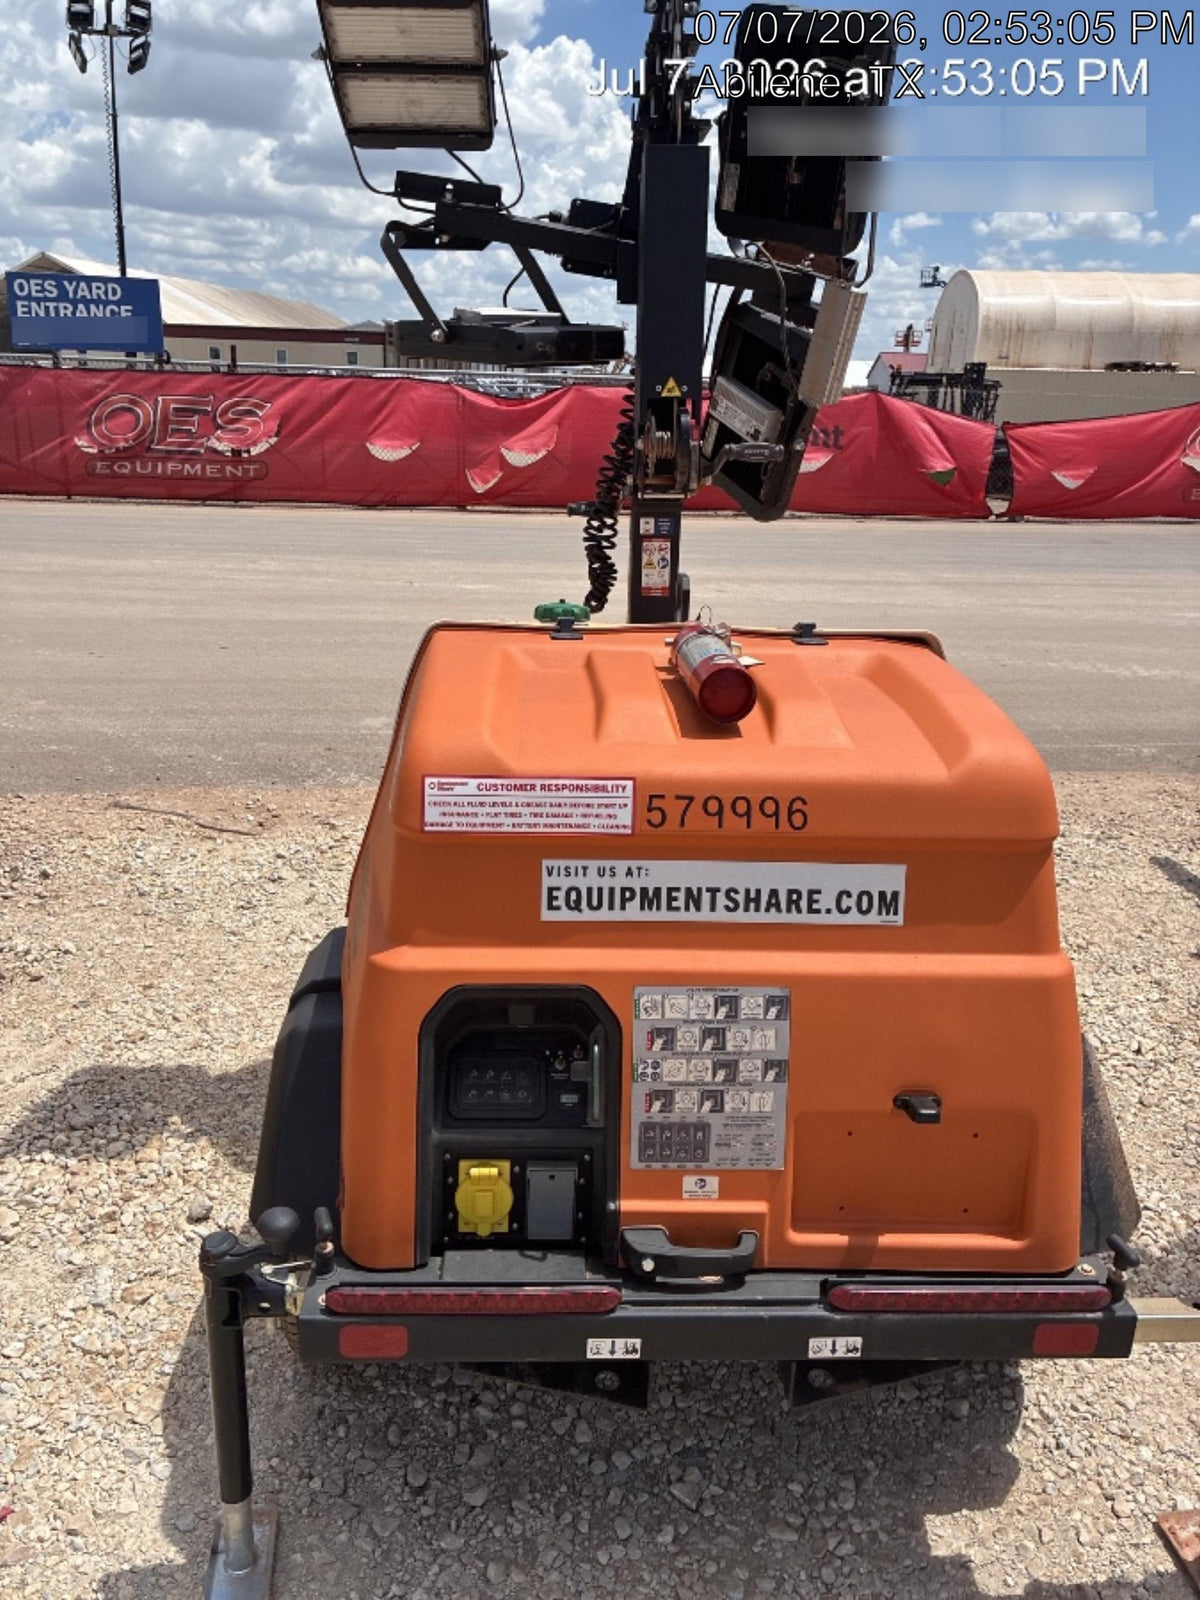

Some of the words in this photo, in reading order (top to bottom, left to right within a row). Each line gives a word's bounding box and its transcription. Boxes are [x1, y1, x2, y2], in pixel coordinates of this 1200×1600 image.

[13, 278, 59, 298] OES
[63, 280, 123, 301] YARD
[88, 394, 273, 453] OES
[94, 461, 260, 478] EQUIPMENT
[476, 782, 537, 793] CUSTOMER
[539, 783, 627, 794] RESPONSIBILITY
[645, 793, 809, 832] 579996
[545, 865, 590, 878] VISIT
[596, 866, 618, 878] US
[624, 866, 650, 879] AT:
[546, 885, 900, 916] EQUIPMENTSHARE.COM
